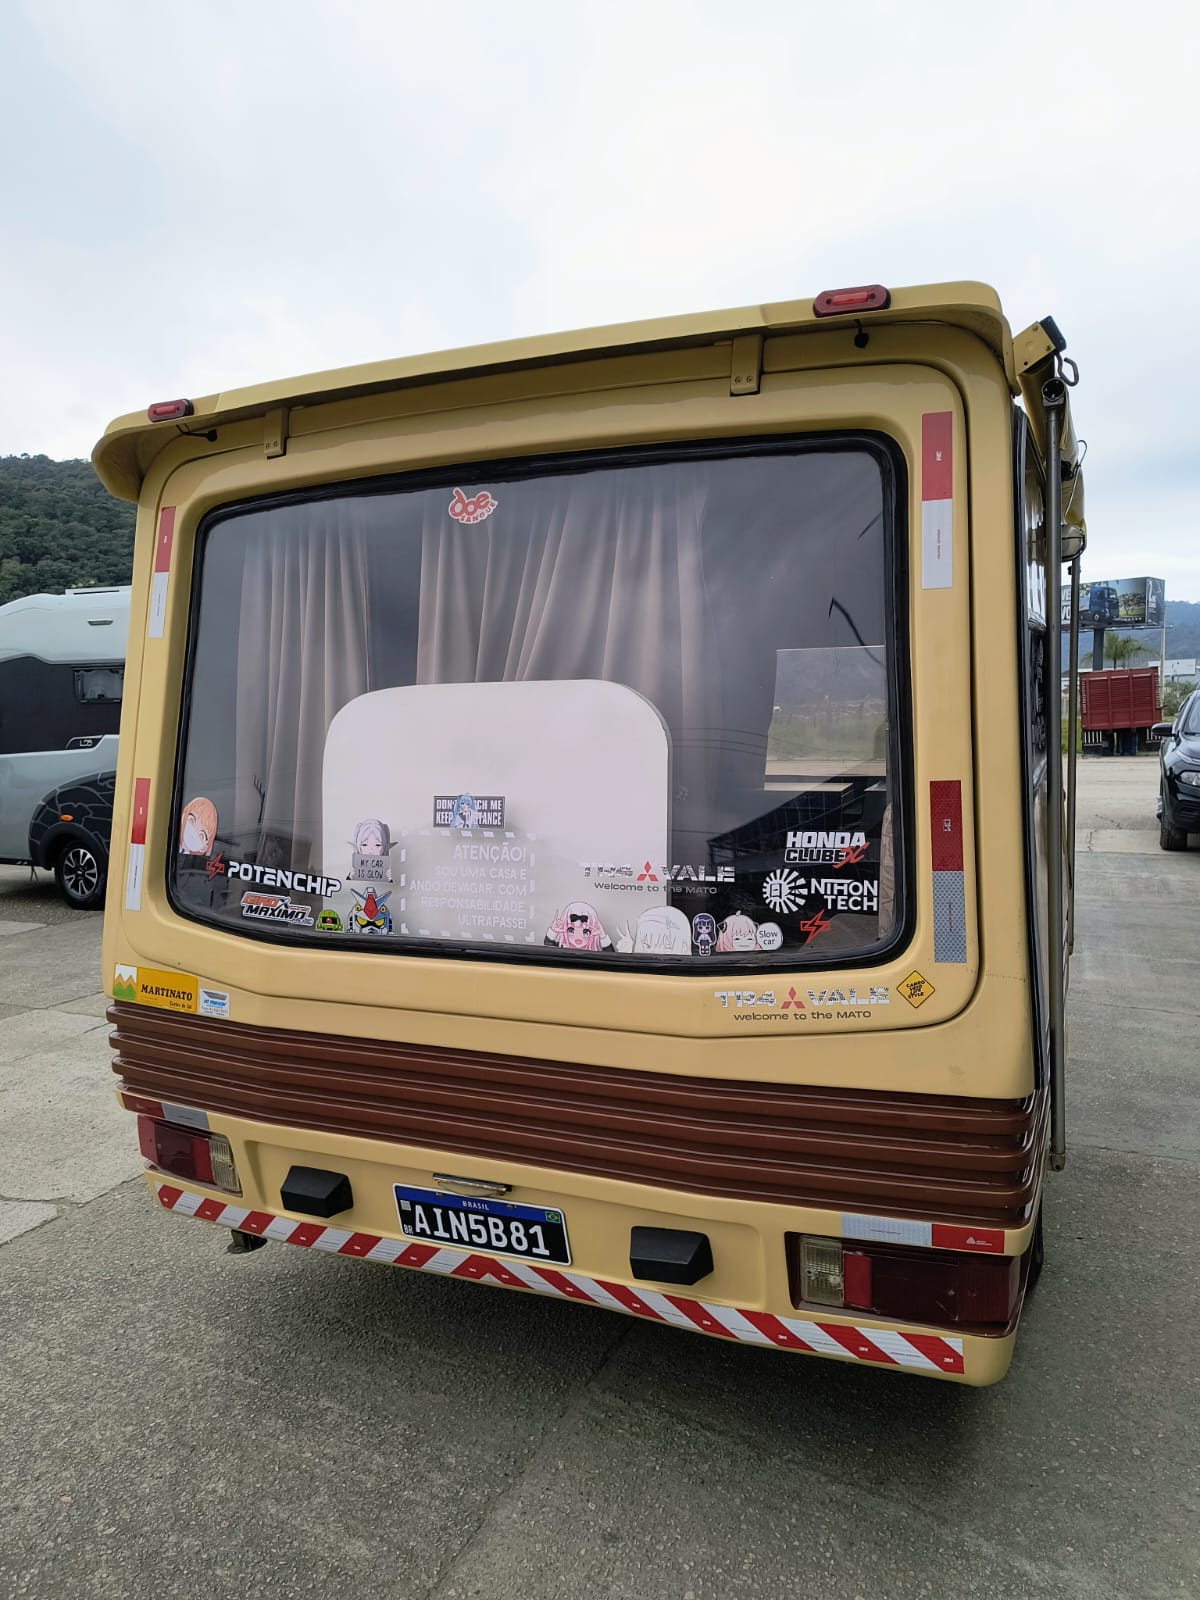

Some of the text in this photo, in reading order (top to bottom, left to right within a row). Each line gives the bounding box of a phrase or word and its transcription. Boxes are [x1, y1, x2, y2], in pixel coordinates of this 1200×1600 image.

[490, 799, 502, 810] ME
[435, 812, 453, 825] KEEP
[786, 831, 866, 848] HONDA
[453, 842, 527, 863] ATENÇÃO!
[785, 848, 847, 864] CLUBE
[360, 858, 384, 869] MY CAR
[227, 860, 342, 897] POTENCHIP
[367, 869, 384, 879] SLOW
[461, 866, 487, 879] UMA
[489, 868, 518, 880] CASA
[520, 869, 527, 880] E
[661, 864, 735, 883] VALE
[410, 880, 442, 892] ANDO
[498, 884, 527, 896] COM
[685, 886, 718, 895] MATO
[810, 878, 878, 897] NIHON
[823, 895, 878, 911] TECH
[759, 930, 778, 939] Slow
[141, 984, 193, 1001] MARTINATO
[807, 987, 890, 1007] VALE
[734, 1010, 872, 1021] welcome to the MATO
[462, 1199, 490, 1211] BRASIL
[403, 1224, 414, 1235] BR
[414, 1204, 550, 1256] AIN5B81
